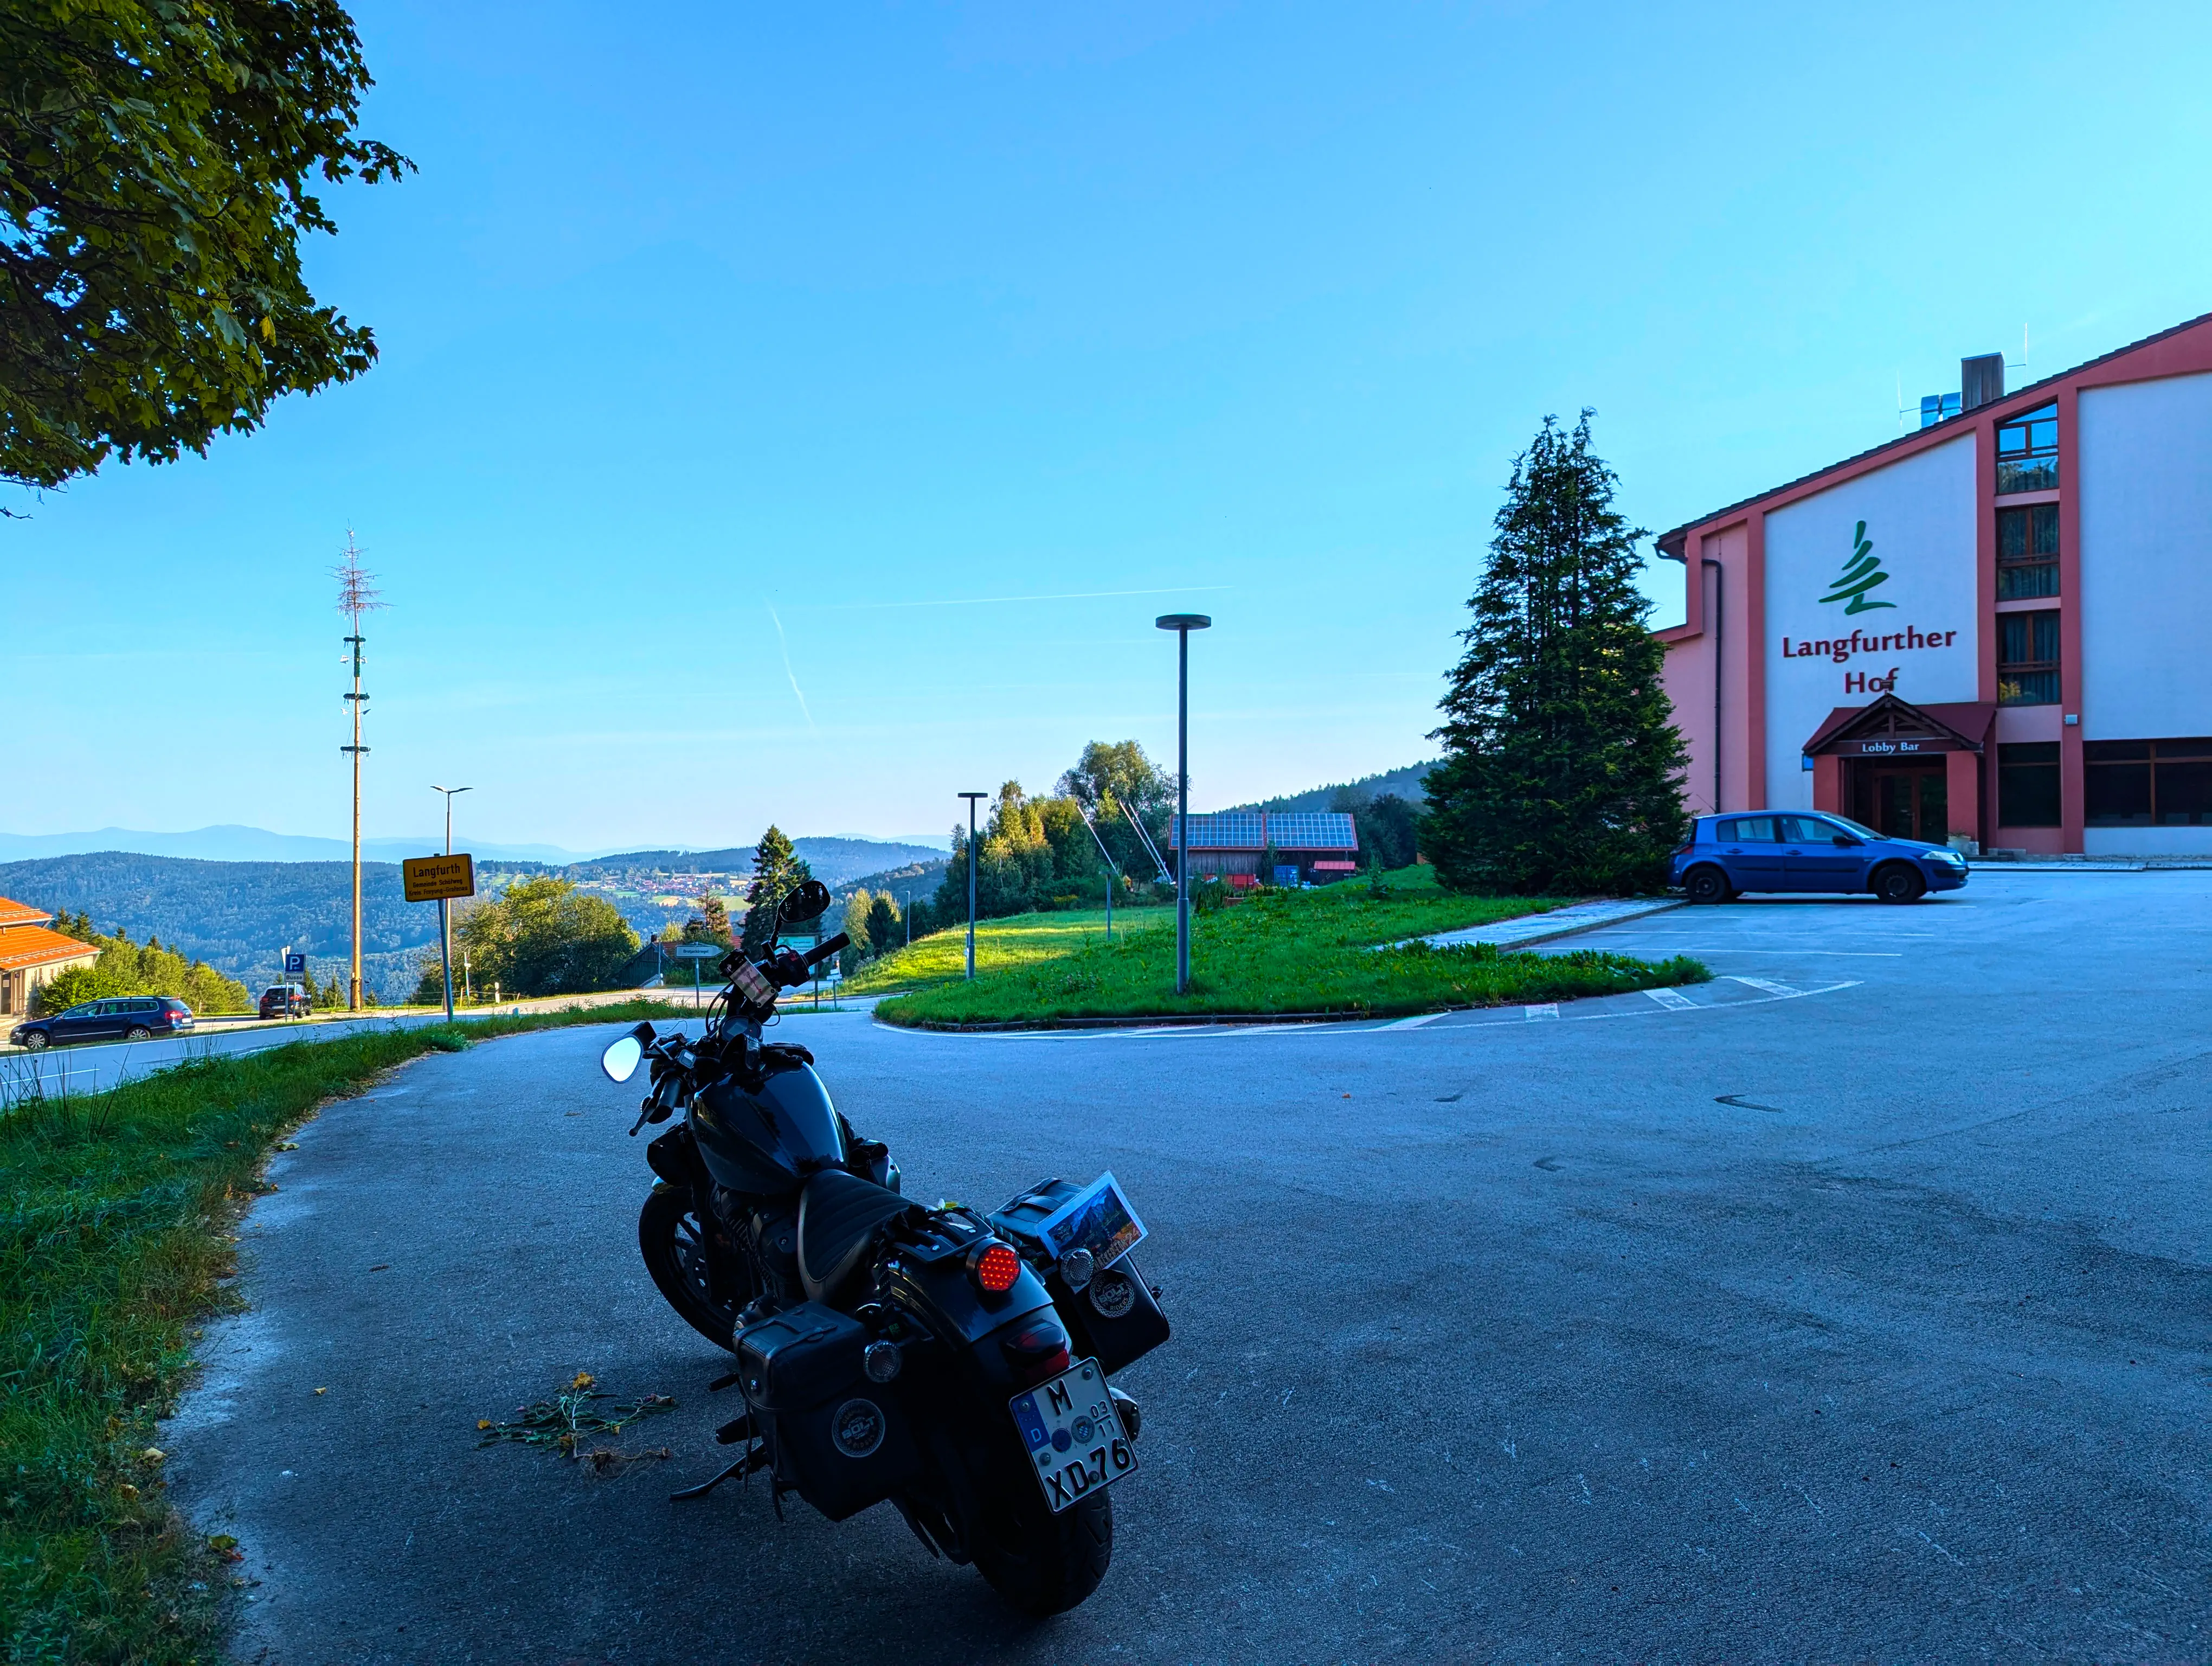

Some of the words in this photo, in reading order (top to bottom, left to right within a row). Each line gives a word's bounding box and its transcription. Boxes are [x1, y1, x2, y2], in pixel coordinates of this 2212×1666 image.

[1782, 625, 1957, 664] Langfurther
[1844, 667, 1900, 694] Hof
[1862, 742, 1896, 754] Lobby
[1900, 741, 1920, 751] Bar
[413, 863, 460, 879] Langfurth
[290, 956, 300, 970] P
[1097, 1283, 1124, 1303] BOLT
[1110, 1297, 1128, 1311] RIDERS
[1046, 1379, 1075, 1416] M
[1090, 1400, 1109, 1418] 03
[841, 1415, 875, 1440] BOLT
[1030, 1427, 1041, 1443] D
[1098, 1419, 1116, 1437] 11
